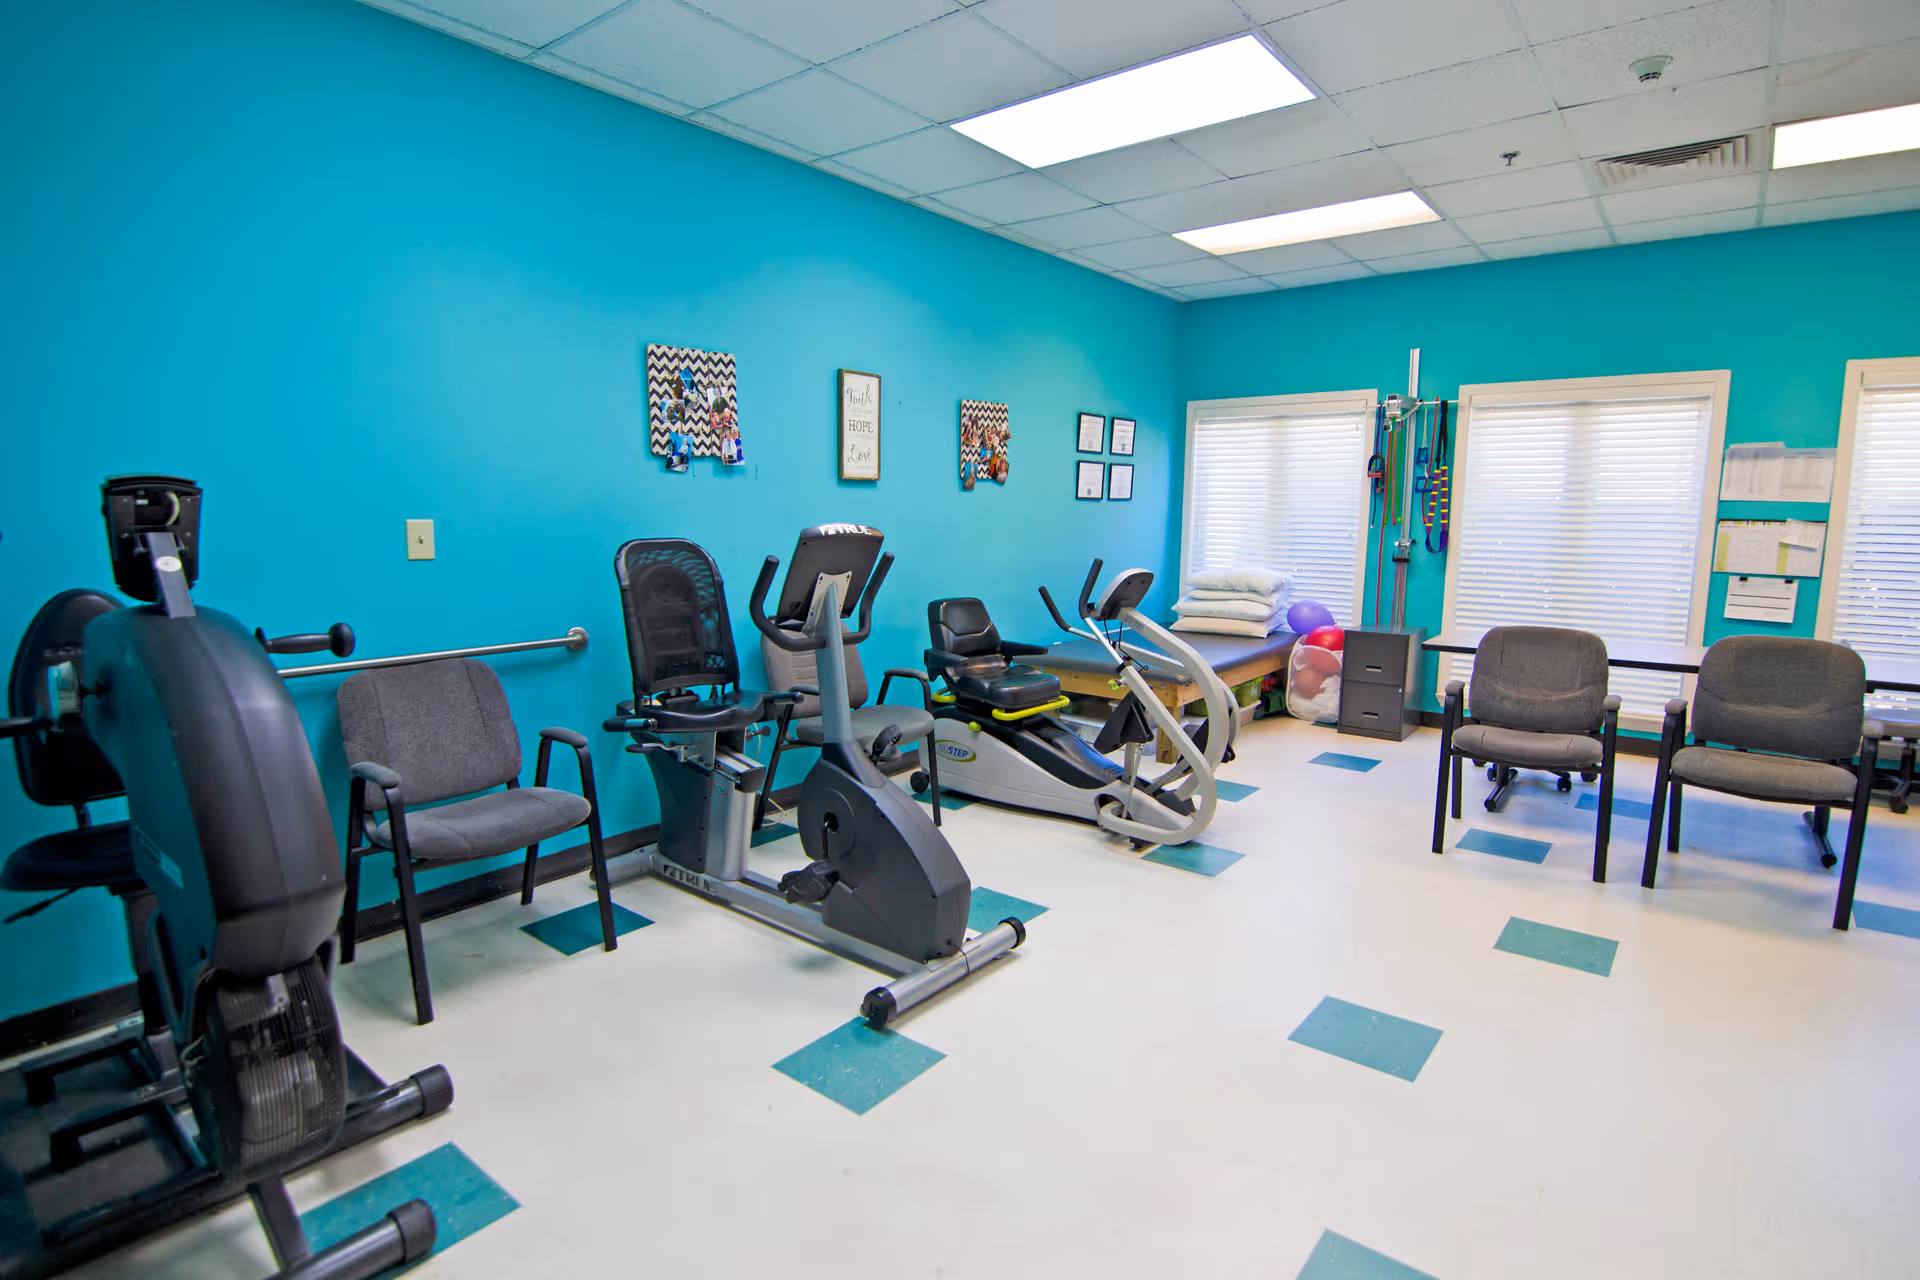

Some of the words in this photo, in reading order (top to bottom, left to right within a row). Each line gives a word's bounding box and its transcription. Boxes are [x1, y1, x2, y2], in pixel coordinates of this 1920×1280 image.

[846, 384, 872, 406] Faith
[848, 419, 873, 433] HOPE
[847, 444, 872, 463] Love
[836, 524, 872, 535] TRUE
